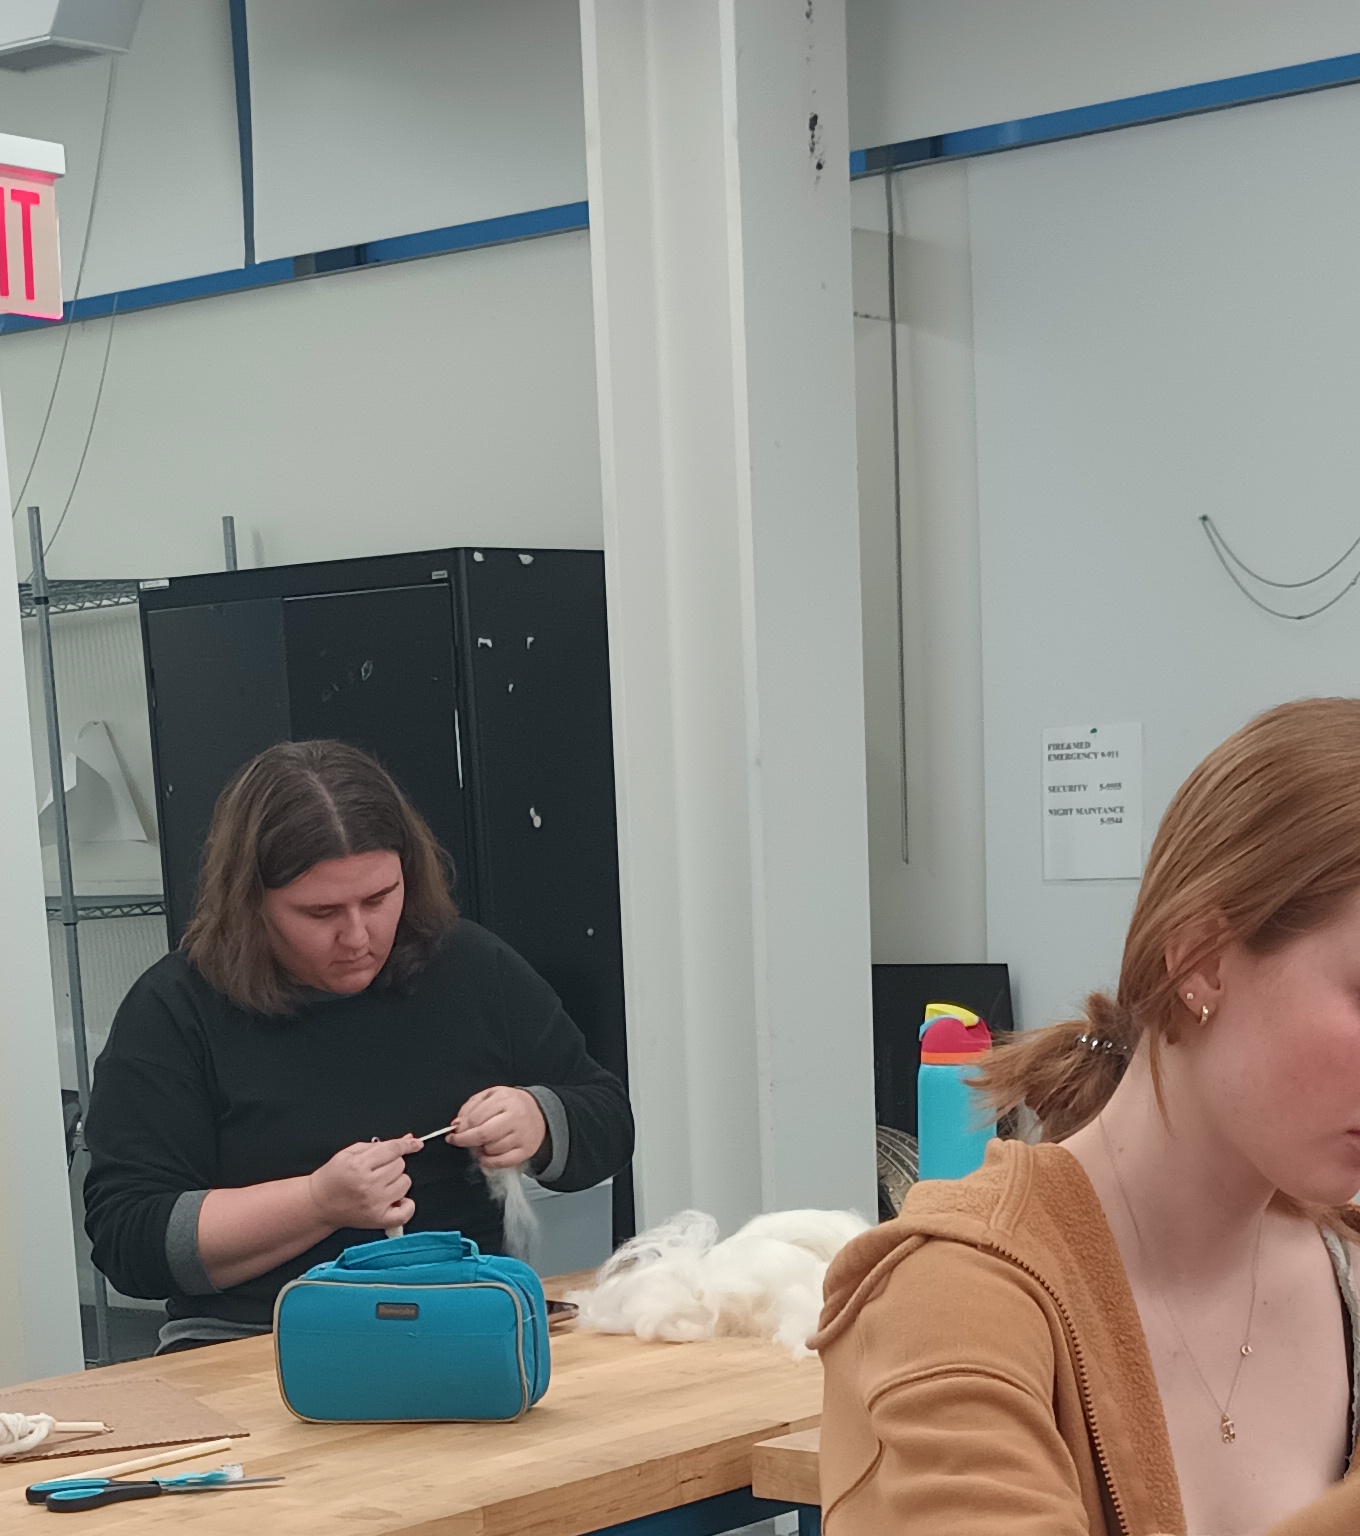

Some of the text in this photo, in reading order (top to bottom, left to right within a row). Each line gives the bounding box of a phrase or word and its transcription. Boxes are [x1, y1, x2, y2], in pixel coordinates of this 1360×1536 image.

[1047, 752, 1098, 761] EMERGENCY
[1047, 784, 1088, 793] SECURITY
[1048, 808, 1073, 816] NIGHT
